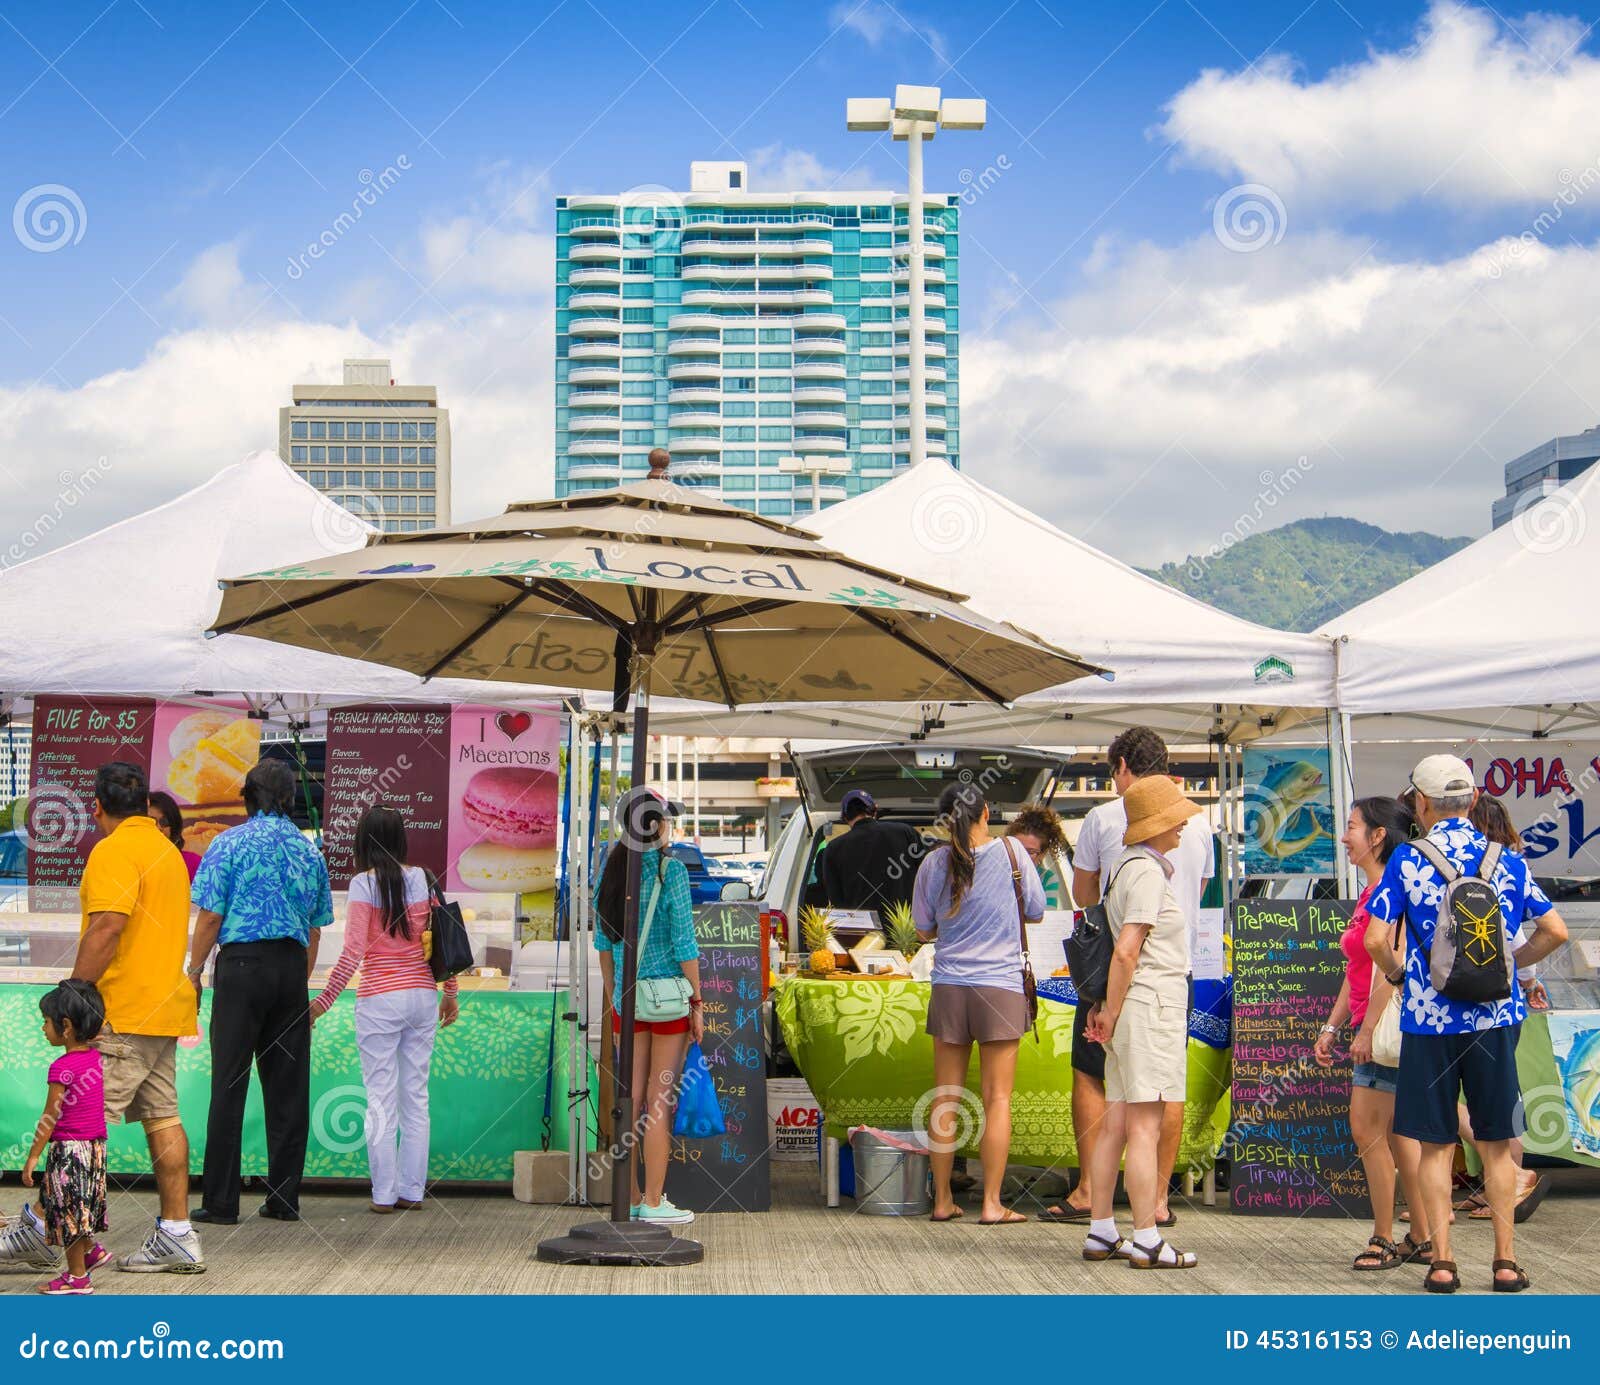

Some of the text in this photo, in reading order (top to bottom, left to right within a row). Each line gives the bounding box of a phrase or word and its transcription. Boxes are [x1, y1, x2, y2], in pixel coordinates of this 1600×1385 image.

[585, 546, 813, 592] Local
[46, 708, 139, 731] FIVE for $5
[332, 711, 371, 724] FRENCH
[423, 712, 445, 727] $2pc
[332, 725, 443, 736] All Natural and Gluten Free
[479, 717, 486, 743] I
[36, 734, 144, 745] All Natural Freshly Baked
[38, 752, 76, 763] Offerings
[331, 748, 361, 758] Flavors
[458, 744, 552, 766] Macarons
[47, 766, 67, 778] layer
[70, 766, 97, 776] Brown
[331, 764, 379, 776] Chocolate
[381, 791, 411, 803] Green
[416, 791, 433, 802] Tea
[402, 818, 443, 830] Caramel
[327, 843, 354, 857] Mang
[34, 855, 71, 867] Meringue
[327, 856, 347, 867] Red
[34, 867, 64, 876] Nutter
[327, 869, 352, 881] Stra
[1237, 905, 1299, 932] Prepared
[1233, 938, 1260, 950] Choose
[1235, 951, 1253, 961] ADD
[1233, 980, 1266, 993] Choose
[702, 1000, 729, 1014] ssic
[1297, 1100, 1351, 1119] Mushroo
